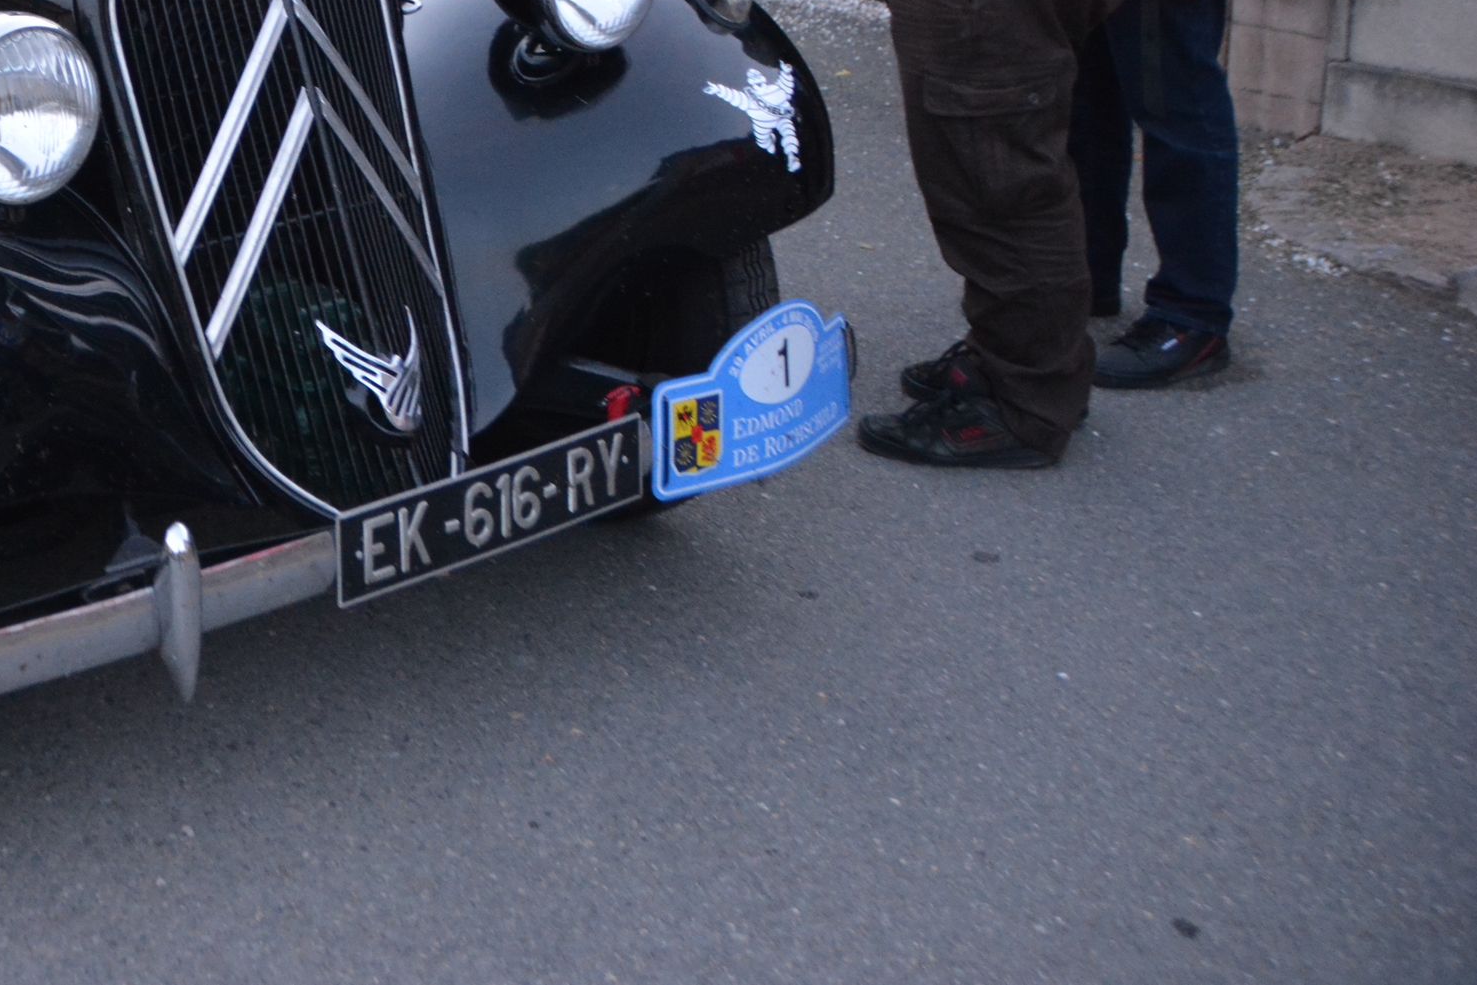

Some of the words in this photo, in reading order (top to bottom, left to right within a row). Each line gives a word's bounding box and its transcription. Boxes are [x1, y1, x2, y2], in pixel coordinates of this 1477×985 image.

[744, 320, 774, 353] AVRIL
[777, 337, 790, 387] 1
[732, 398, 804, 441] EDMOND
[732, 444, 760, 468] DE
[763, 401, 838, 459] ROTHSCHILD
